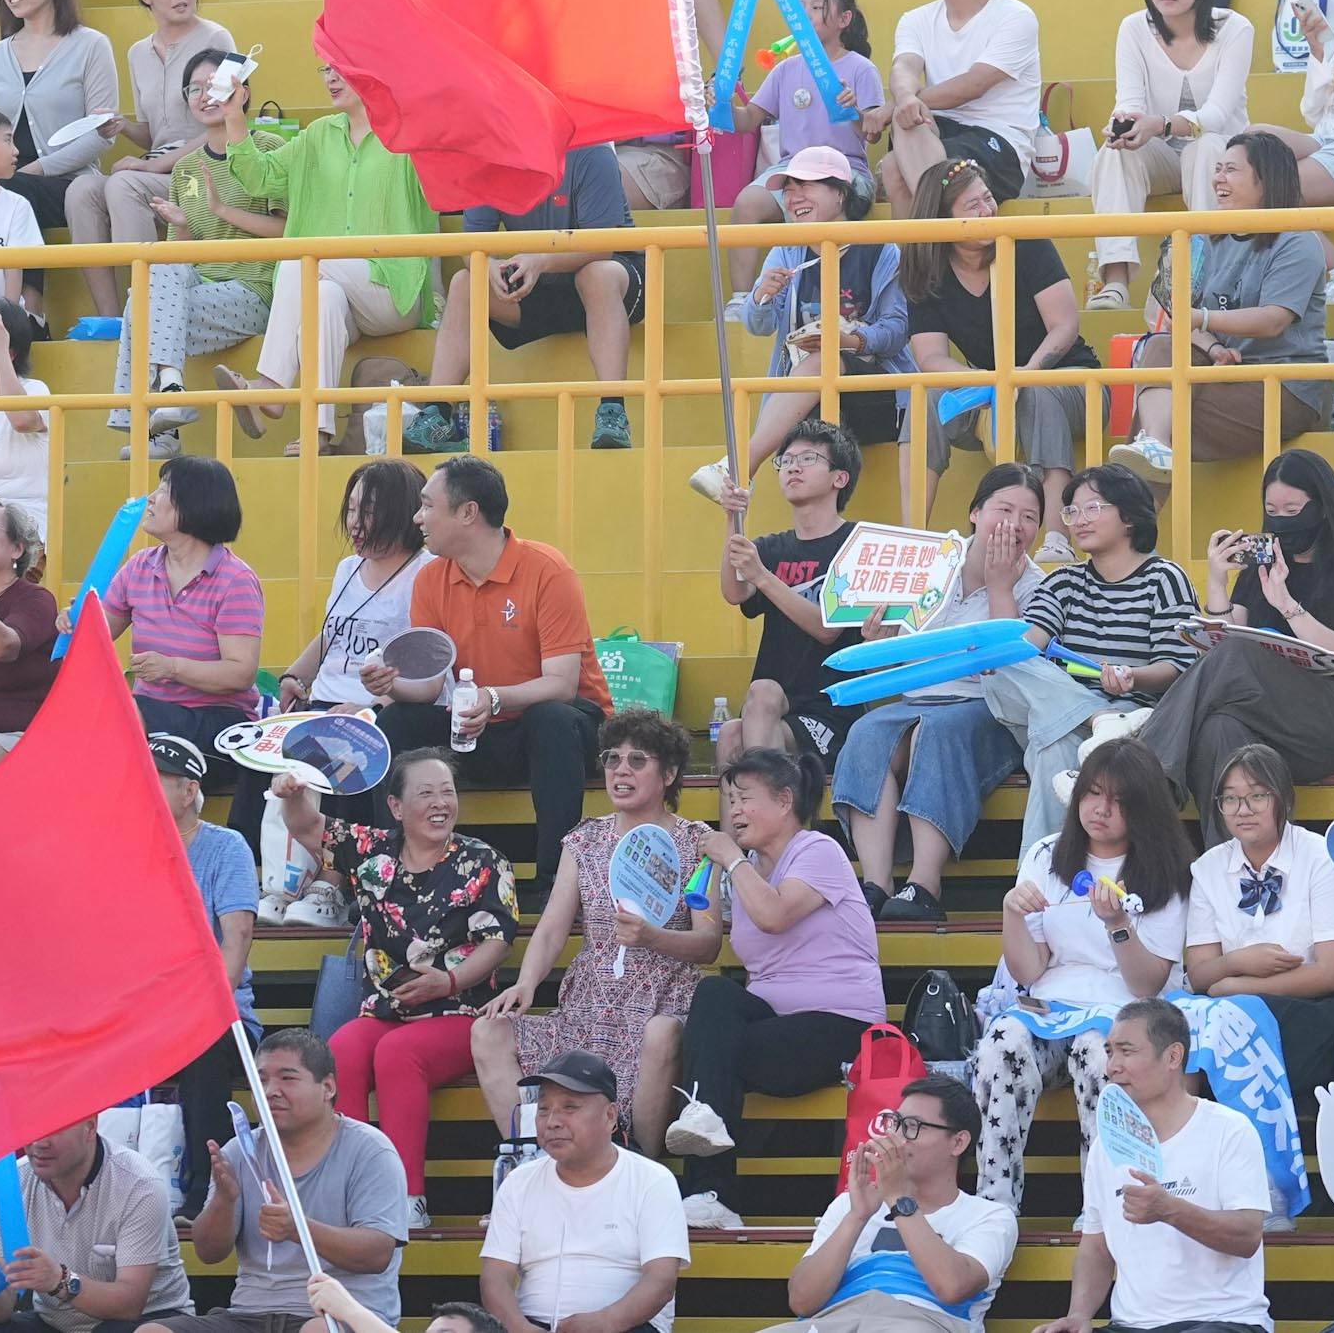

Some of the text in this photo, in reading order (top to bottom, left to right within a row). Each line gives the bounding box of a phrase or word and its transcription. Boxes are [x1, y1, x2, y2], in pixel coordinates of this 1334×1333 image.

[857, 542, 937, 569] 配合精妙
[776, 561, 820, 585] JUST
[848, 569, 929, 595] 攻防有道
[798, 715, 828, 755] adidas
